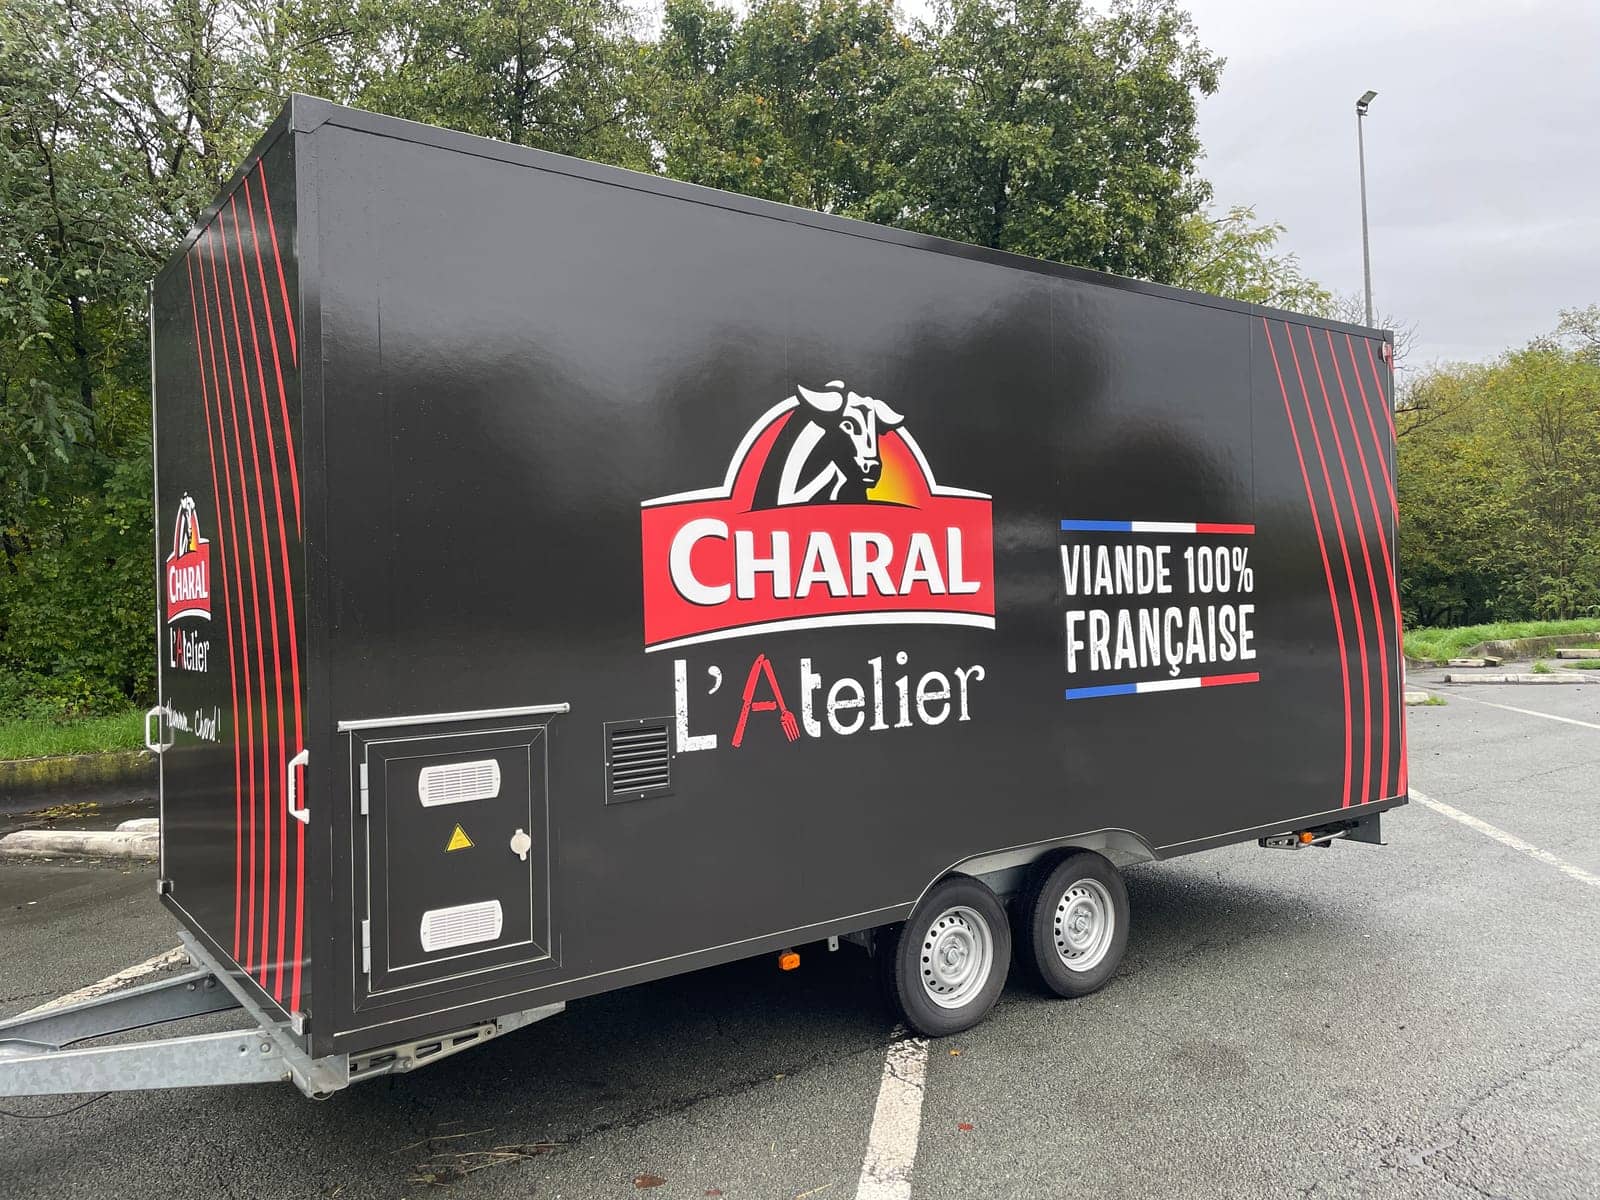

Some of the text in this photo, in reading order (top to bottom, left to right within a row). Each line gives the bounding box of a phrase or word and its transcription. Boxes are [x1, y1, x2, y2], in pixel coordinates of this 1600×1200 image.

[169, 560, 209, 604] CHARAL
[669, 517, 982, 606] CHARAL
[1060, 544, 1254, 596] VIANDE 100%
[168, 627, 210, 673] L'Atelier
[1065, 604, 1257, 677] FRANÇAISE
[673, 650, 985, 753] L'Atelier
